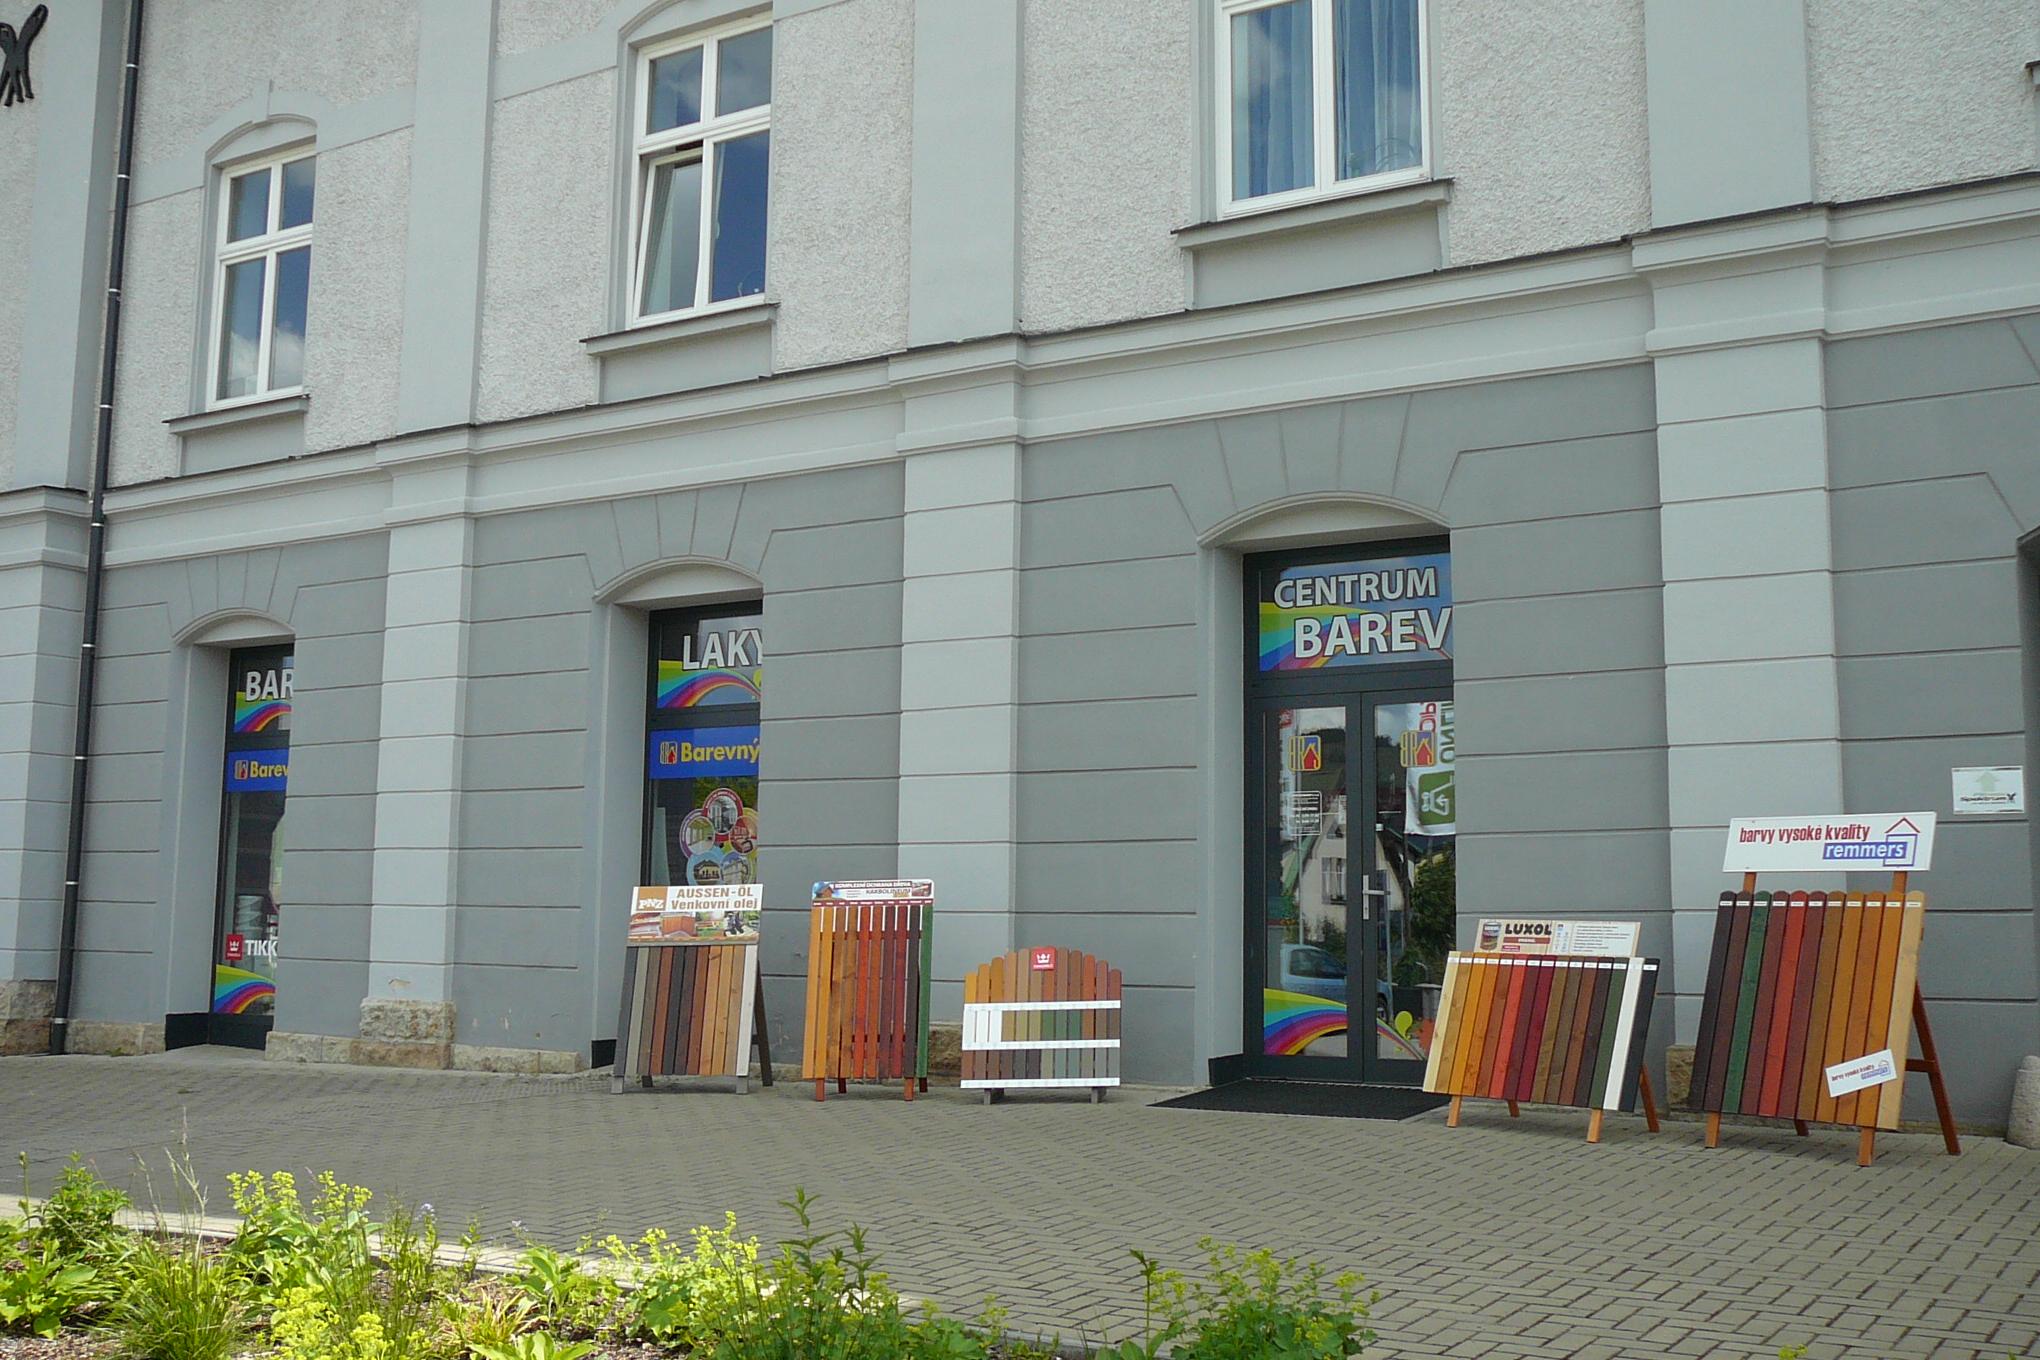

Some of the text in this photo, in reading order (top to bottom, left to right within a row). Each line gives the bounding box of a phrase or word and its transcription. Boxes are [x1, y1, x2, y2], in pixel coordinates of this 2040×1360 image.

[1273, 566, 1437, 609] CENTRUM
[1294, 606, 1451, 659] BAREV
[1739, 827, 1776, 844] barvy
[1824, 823, 1871, 842] kvality
[1825, 843, 1905, 858] remmers
[734, 898, 758, 910] olej
[1504, 923, 1552, 936] LUXOL
